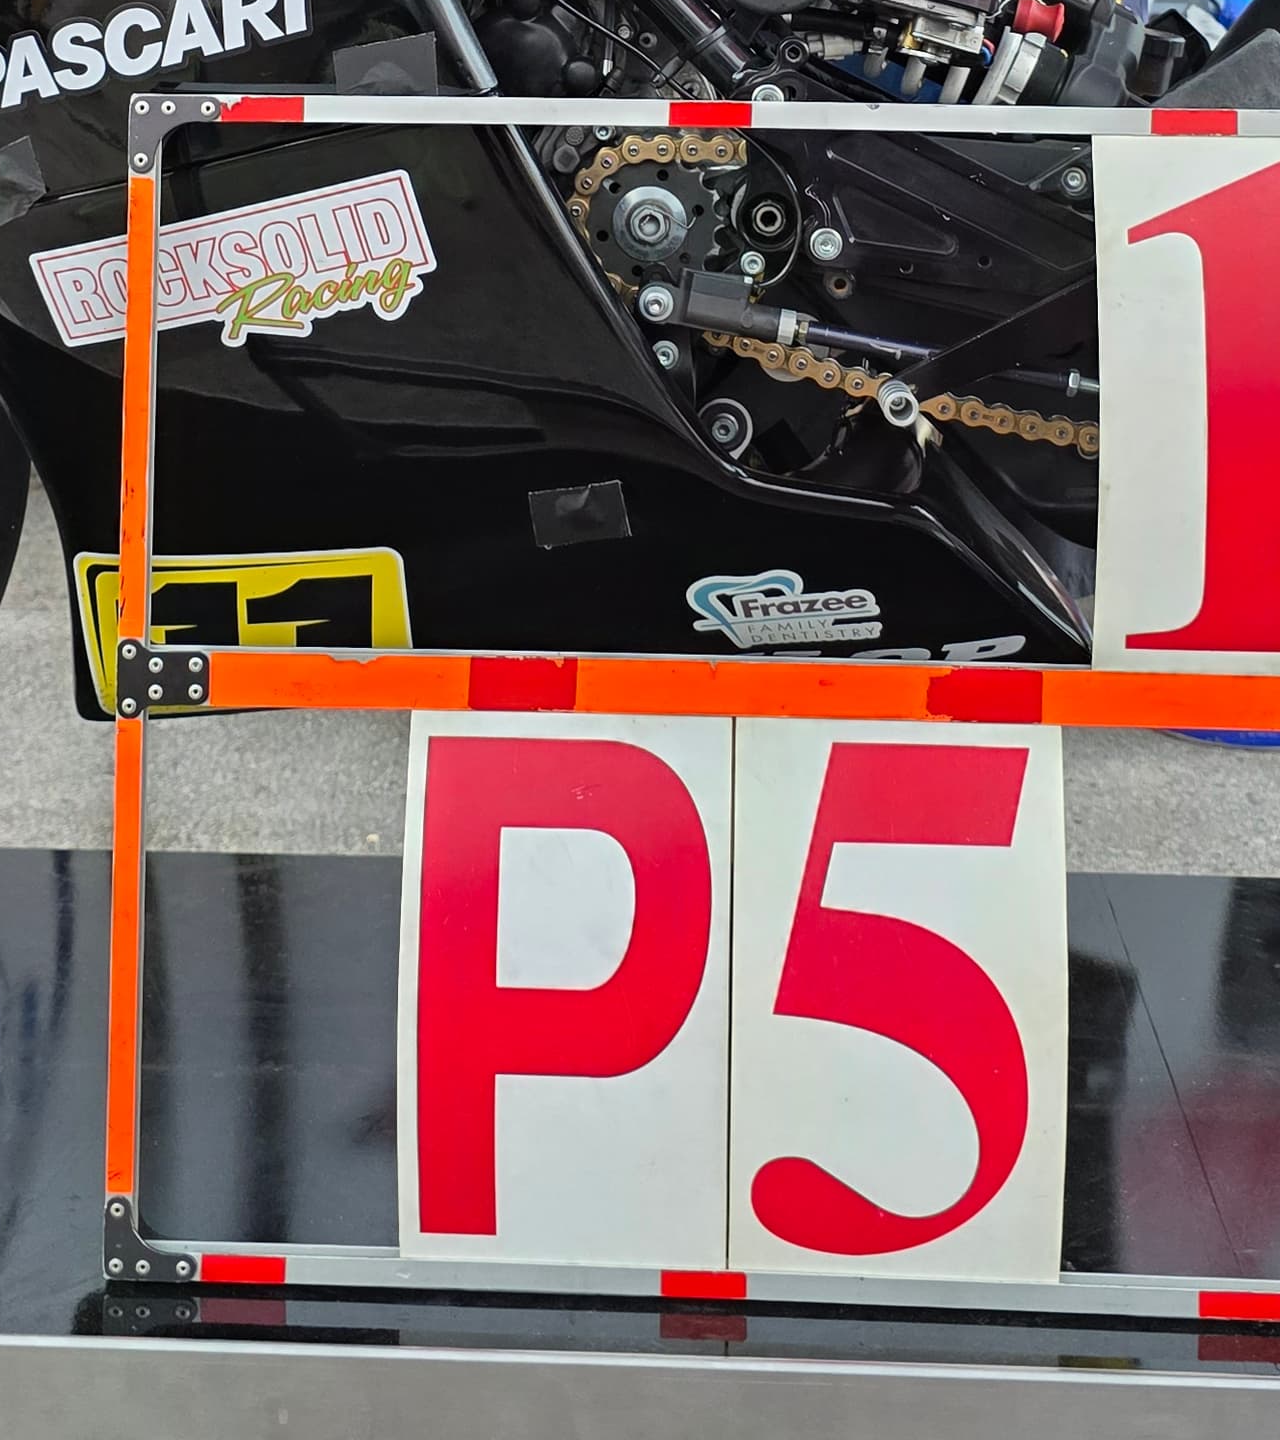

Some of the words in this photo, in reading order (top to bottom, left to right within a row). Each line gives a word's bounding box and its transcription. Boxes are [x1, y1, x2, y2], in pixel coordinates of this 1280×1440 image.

[52, 196, 410, 329] ROCKSOLID
[217, 254, 416, 340] Racing
[738, 595, 868, 619] Frazee
[746, 619, 829, 634] FAMILY
[750, 625, 881, 644] DENTISTRY
[418, 738, 1028, 1255] P5
